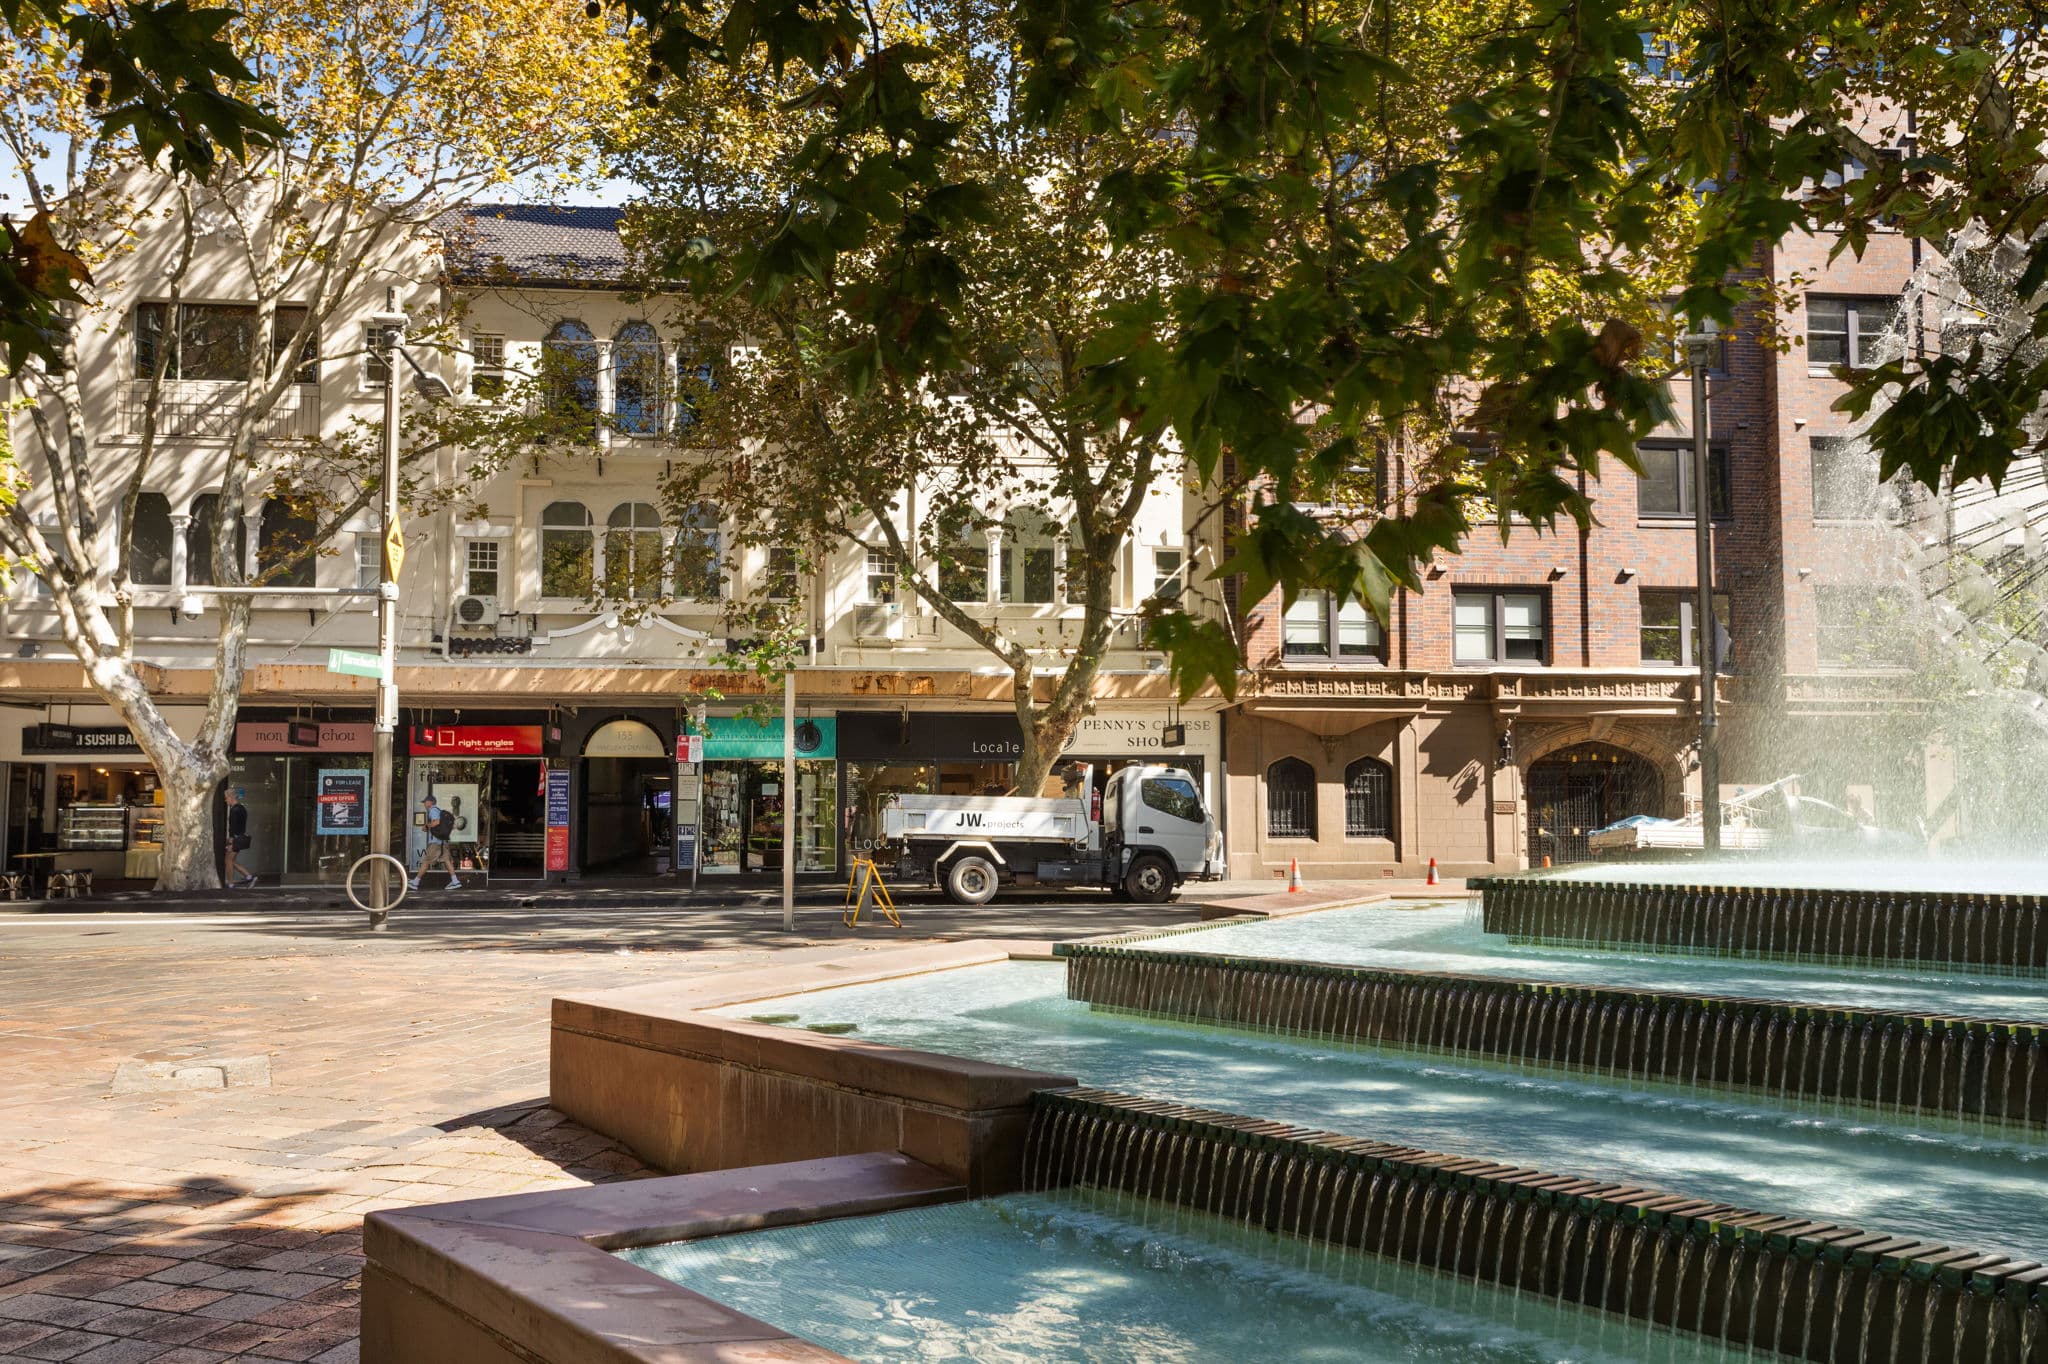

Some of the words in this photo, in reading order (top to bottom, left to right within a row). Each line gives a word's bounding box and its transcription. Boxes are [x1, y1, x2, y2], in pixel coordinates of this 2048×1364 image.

[1083, 720, 1146, 730] PENNY'S
[256, 732, 282, 740] mon
[321, 729, 355, 740] chou
[84, 734, 116, 746] SUSHI
[458, 739, 482, 747] right
[484, 739, 514, 747] angles
[1127, 737, 1163, 746] SHO
